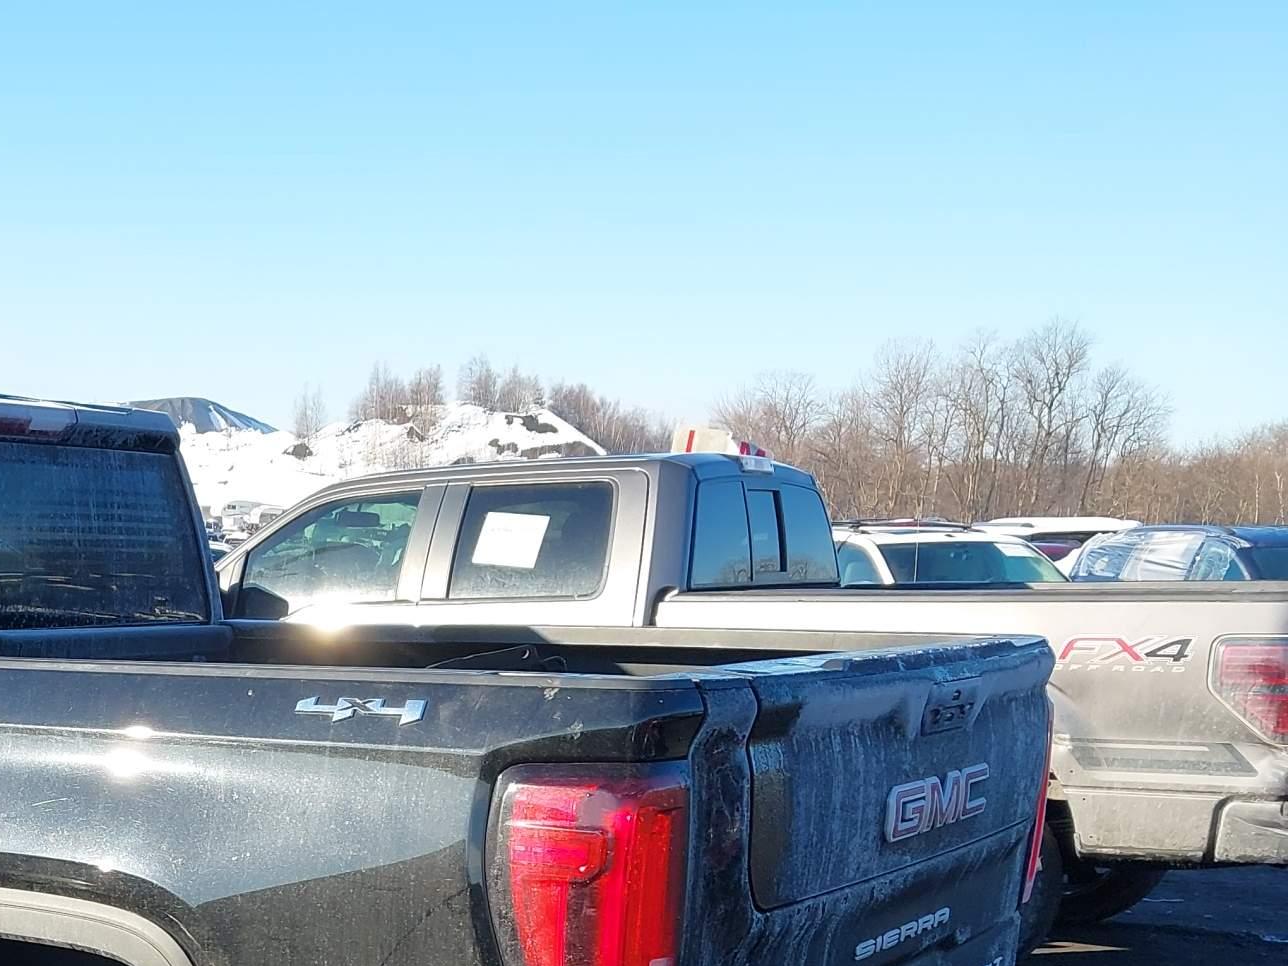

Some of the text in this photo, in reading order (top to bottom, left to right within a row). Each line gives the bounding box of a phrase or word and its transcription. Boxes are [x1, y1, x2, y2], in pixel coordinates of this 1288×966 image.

[1058, 635, 1194, 663] FX4
[1112, 664, 1185, 673] ROAD
[885, 762, 990, 843] GMC
[854, 906, 951, 961] SIERRA
